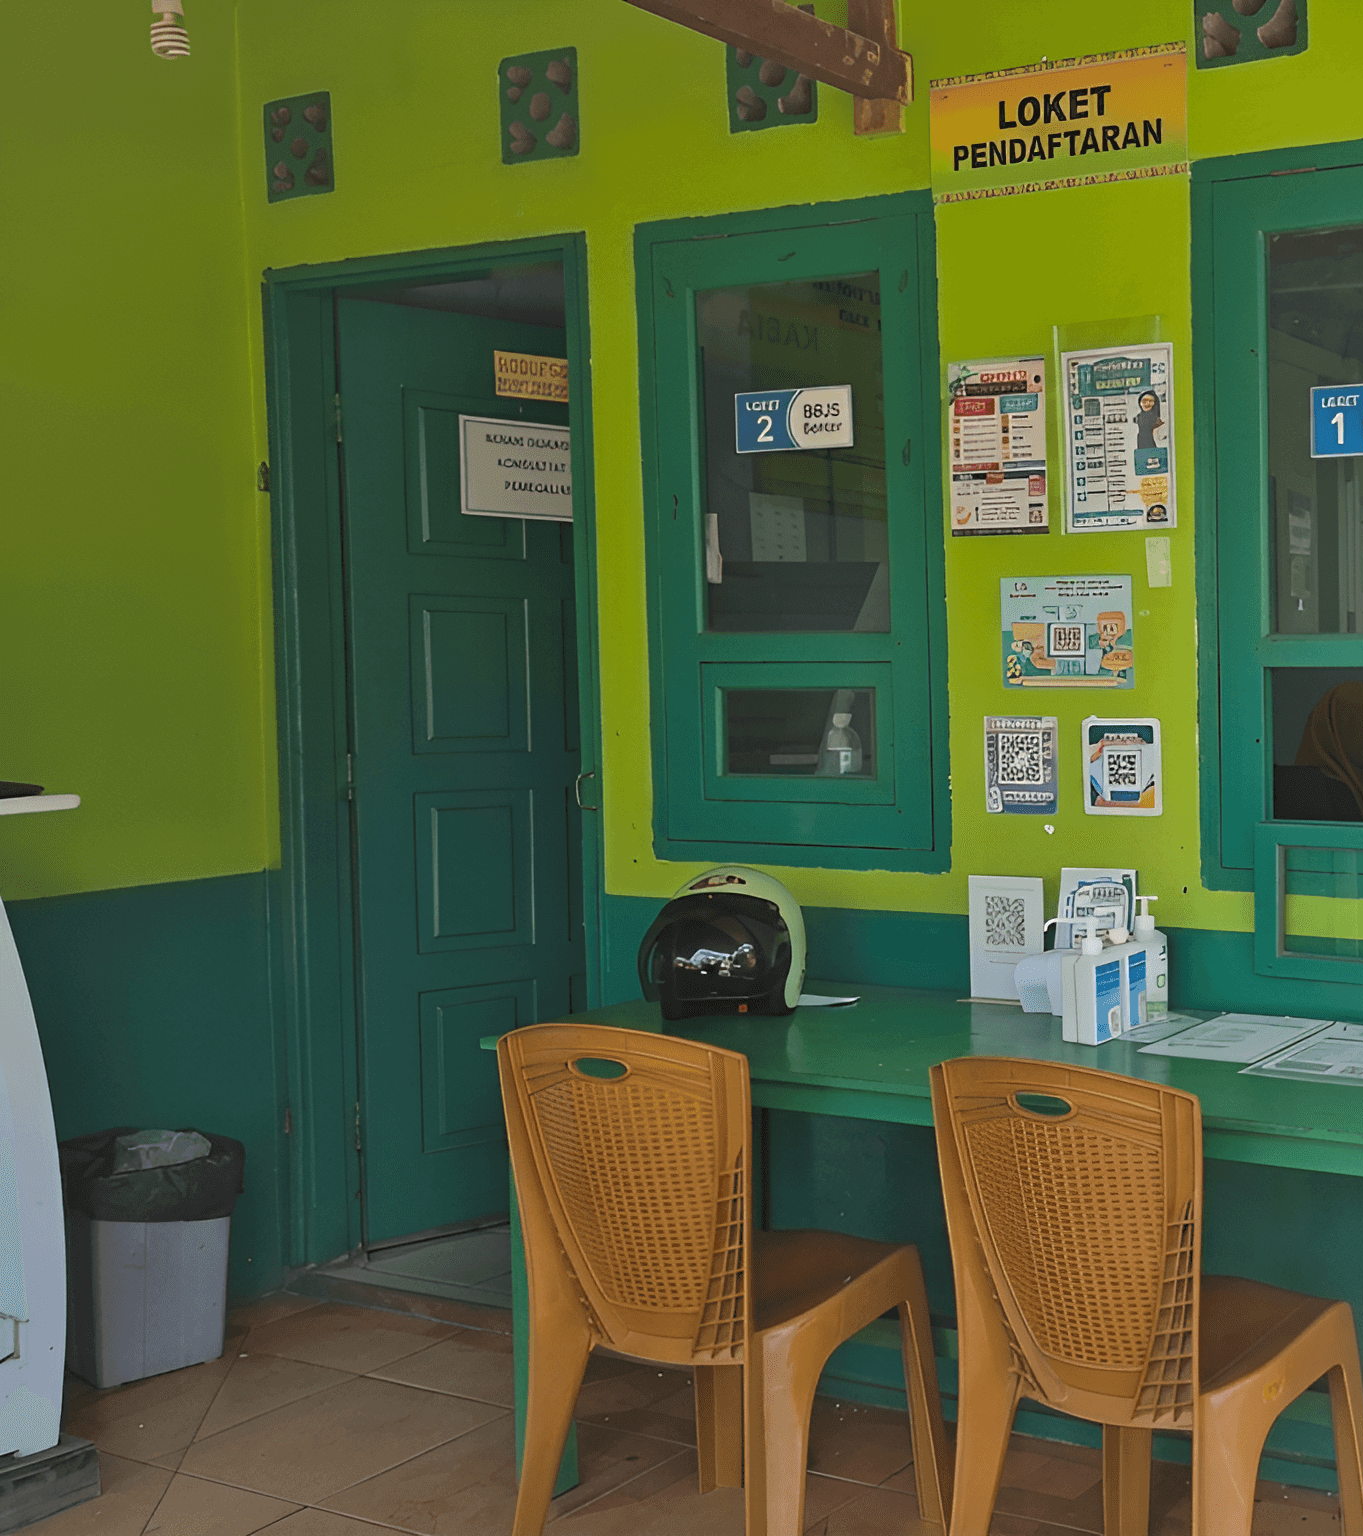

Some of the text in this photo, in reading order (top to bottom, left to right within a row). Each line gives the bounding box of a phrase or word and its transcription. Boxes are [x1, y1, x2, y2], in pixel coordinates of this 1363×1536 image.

[998, 85, 1111, 130] LOKET
[953, 118, 1162, 171] PENDAFTARAN
[757, 415, 775, 442] 2
[1331, 412, 1344, 445] 1
